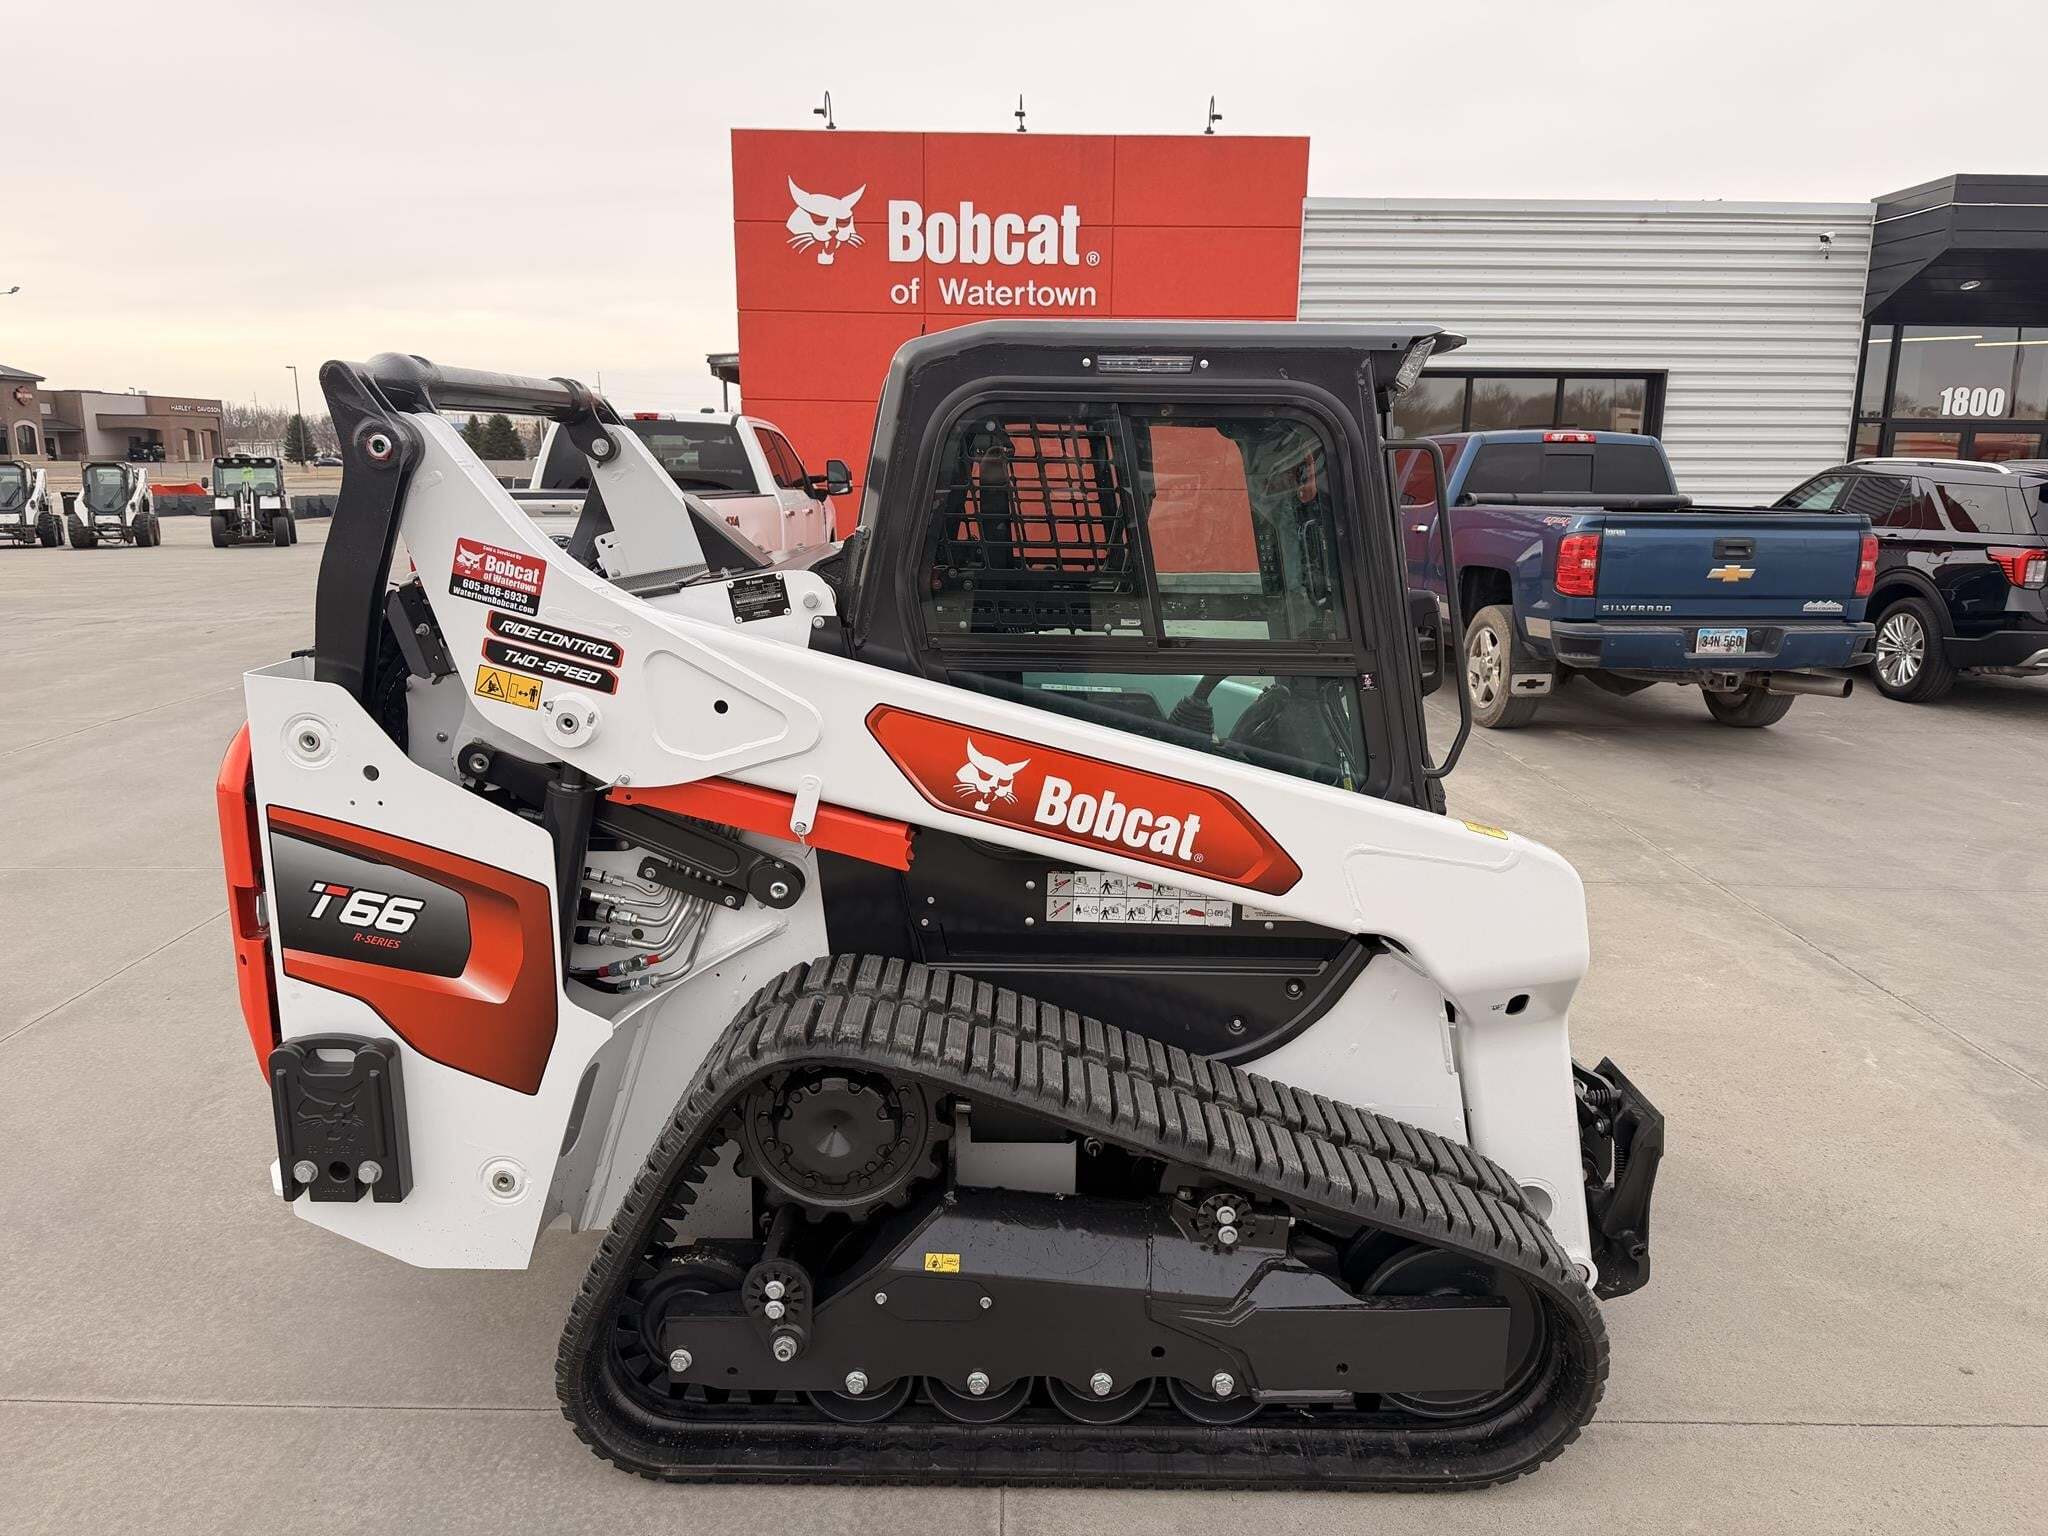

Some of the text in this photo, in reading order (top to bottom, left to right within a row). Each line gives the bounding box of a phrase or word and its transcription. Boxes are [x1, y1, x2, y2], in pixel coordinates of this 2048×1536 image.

[888, 199, 1081, 266] Bobcat
[890, 277, 1097, 306] of Watertown
[1940, 386, 2005, 417] 1800
[483, 572, 537, 593] of Watertown
[484, 553, 540, 585] Bobcat
[453, 586, 535, 614] WatertownBobcat.com
[462, 578, 528, 604] 605-886-6933
[1602, 604, 1672, 612] SILVERADO
[499, 620, 614, 660] RIDE CONTROL
[504, 649, 602, 684] TWO-SPEED
[1034, 775, 1201, 861] Bobcat
[310, 882, 424, 934] T66
[353, 932, 401, 949] R-SERIES
